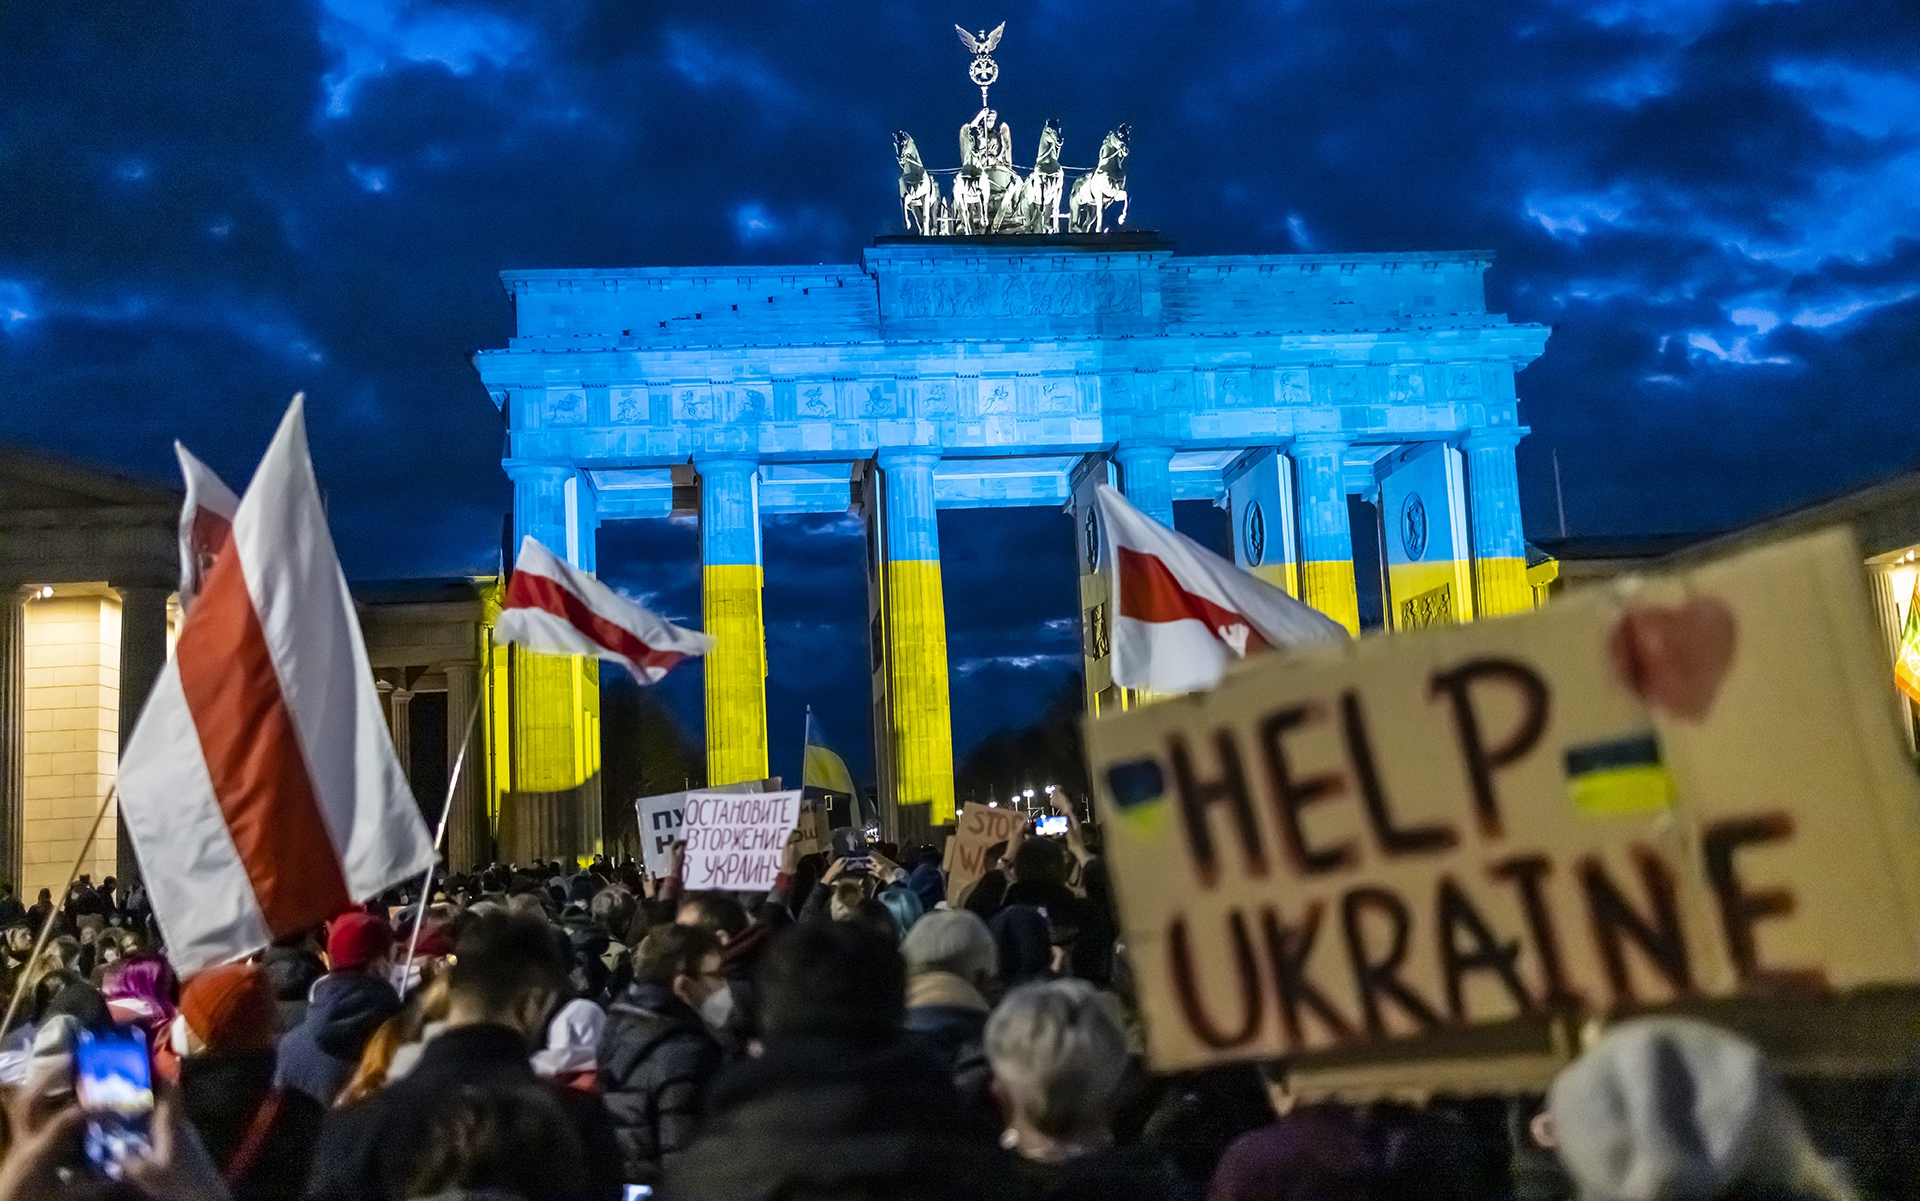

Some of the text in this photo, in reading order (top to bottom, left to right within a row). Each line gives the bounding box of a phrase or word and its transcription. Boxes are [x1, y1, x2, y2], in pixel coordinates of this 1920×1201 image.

[685, 798, 791, 826] ОСТАНОВИТЕ
[1165, 656, 1550, 888] HELP
[686, 827, 789, 852] ВТОРЖЕНИЕ
[1167, 810, 1830, 1052] UKRAINE
